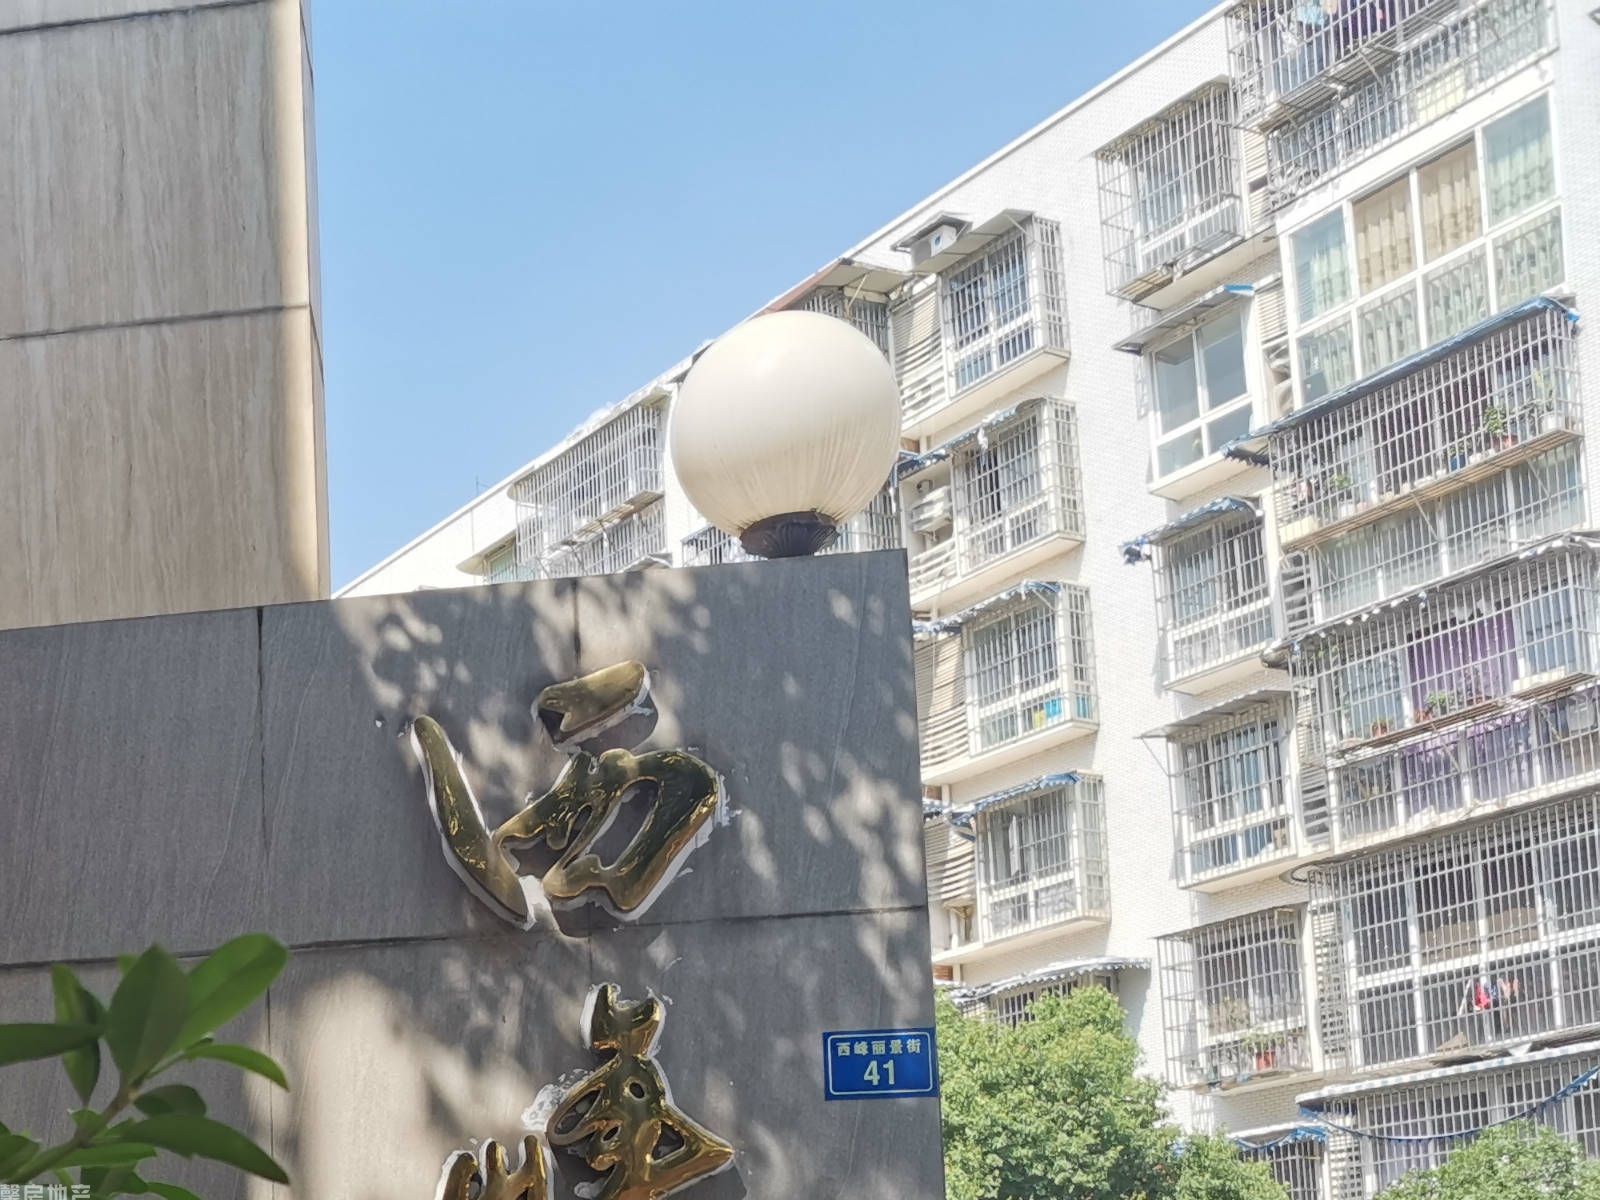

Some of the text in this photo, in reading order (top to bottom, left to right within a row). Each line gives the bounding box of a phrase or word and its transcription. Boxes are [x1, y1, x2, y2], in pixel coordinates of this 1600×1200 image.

[836, 1039, 921, 1057] 西峰丽景街
[864, 1059, 895, 1086] 41
